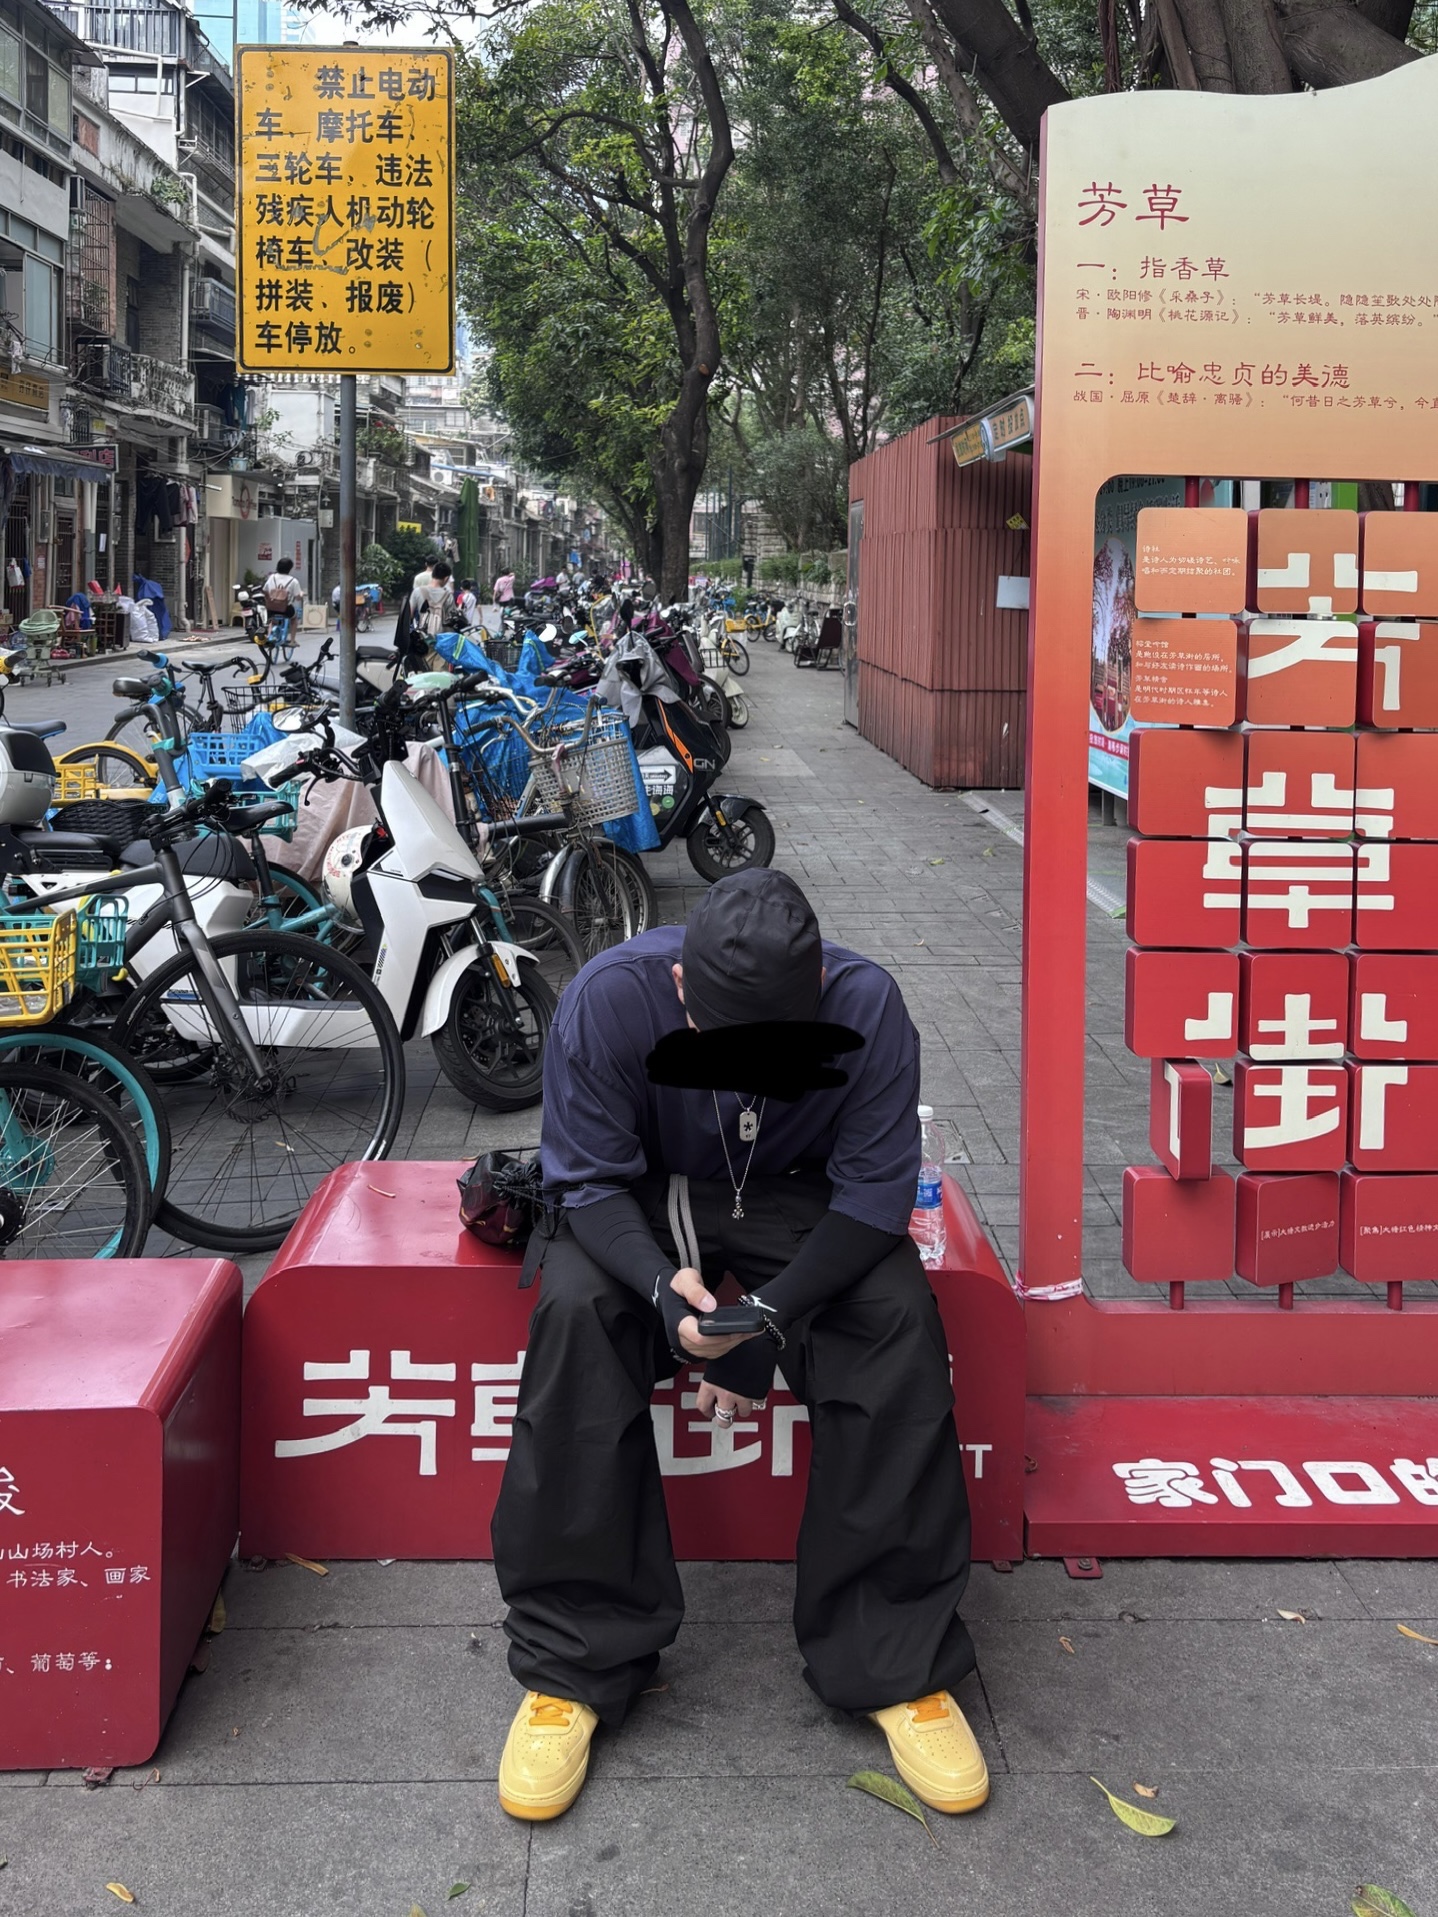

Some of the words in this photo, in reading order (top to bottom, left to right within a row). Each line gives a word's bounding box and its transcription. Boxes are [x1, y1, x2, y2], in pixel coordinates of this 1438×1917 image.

[317, 65, 435, 101] 禁止电动
[255, 153, 433, 188] 三轮车、违法
[256, 194, 435, 229] 残疾人机动轮
[1078, 181, 1190, 231] 芳草
[255, 321, 356, 354] 车停放。
[1142, 545, 1161, 554] 诗社
[0, 1541, 113, 1560] 山场村人。
